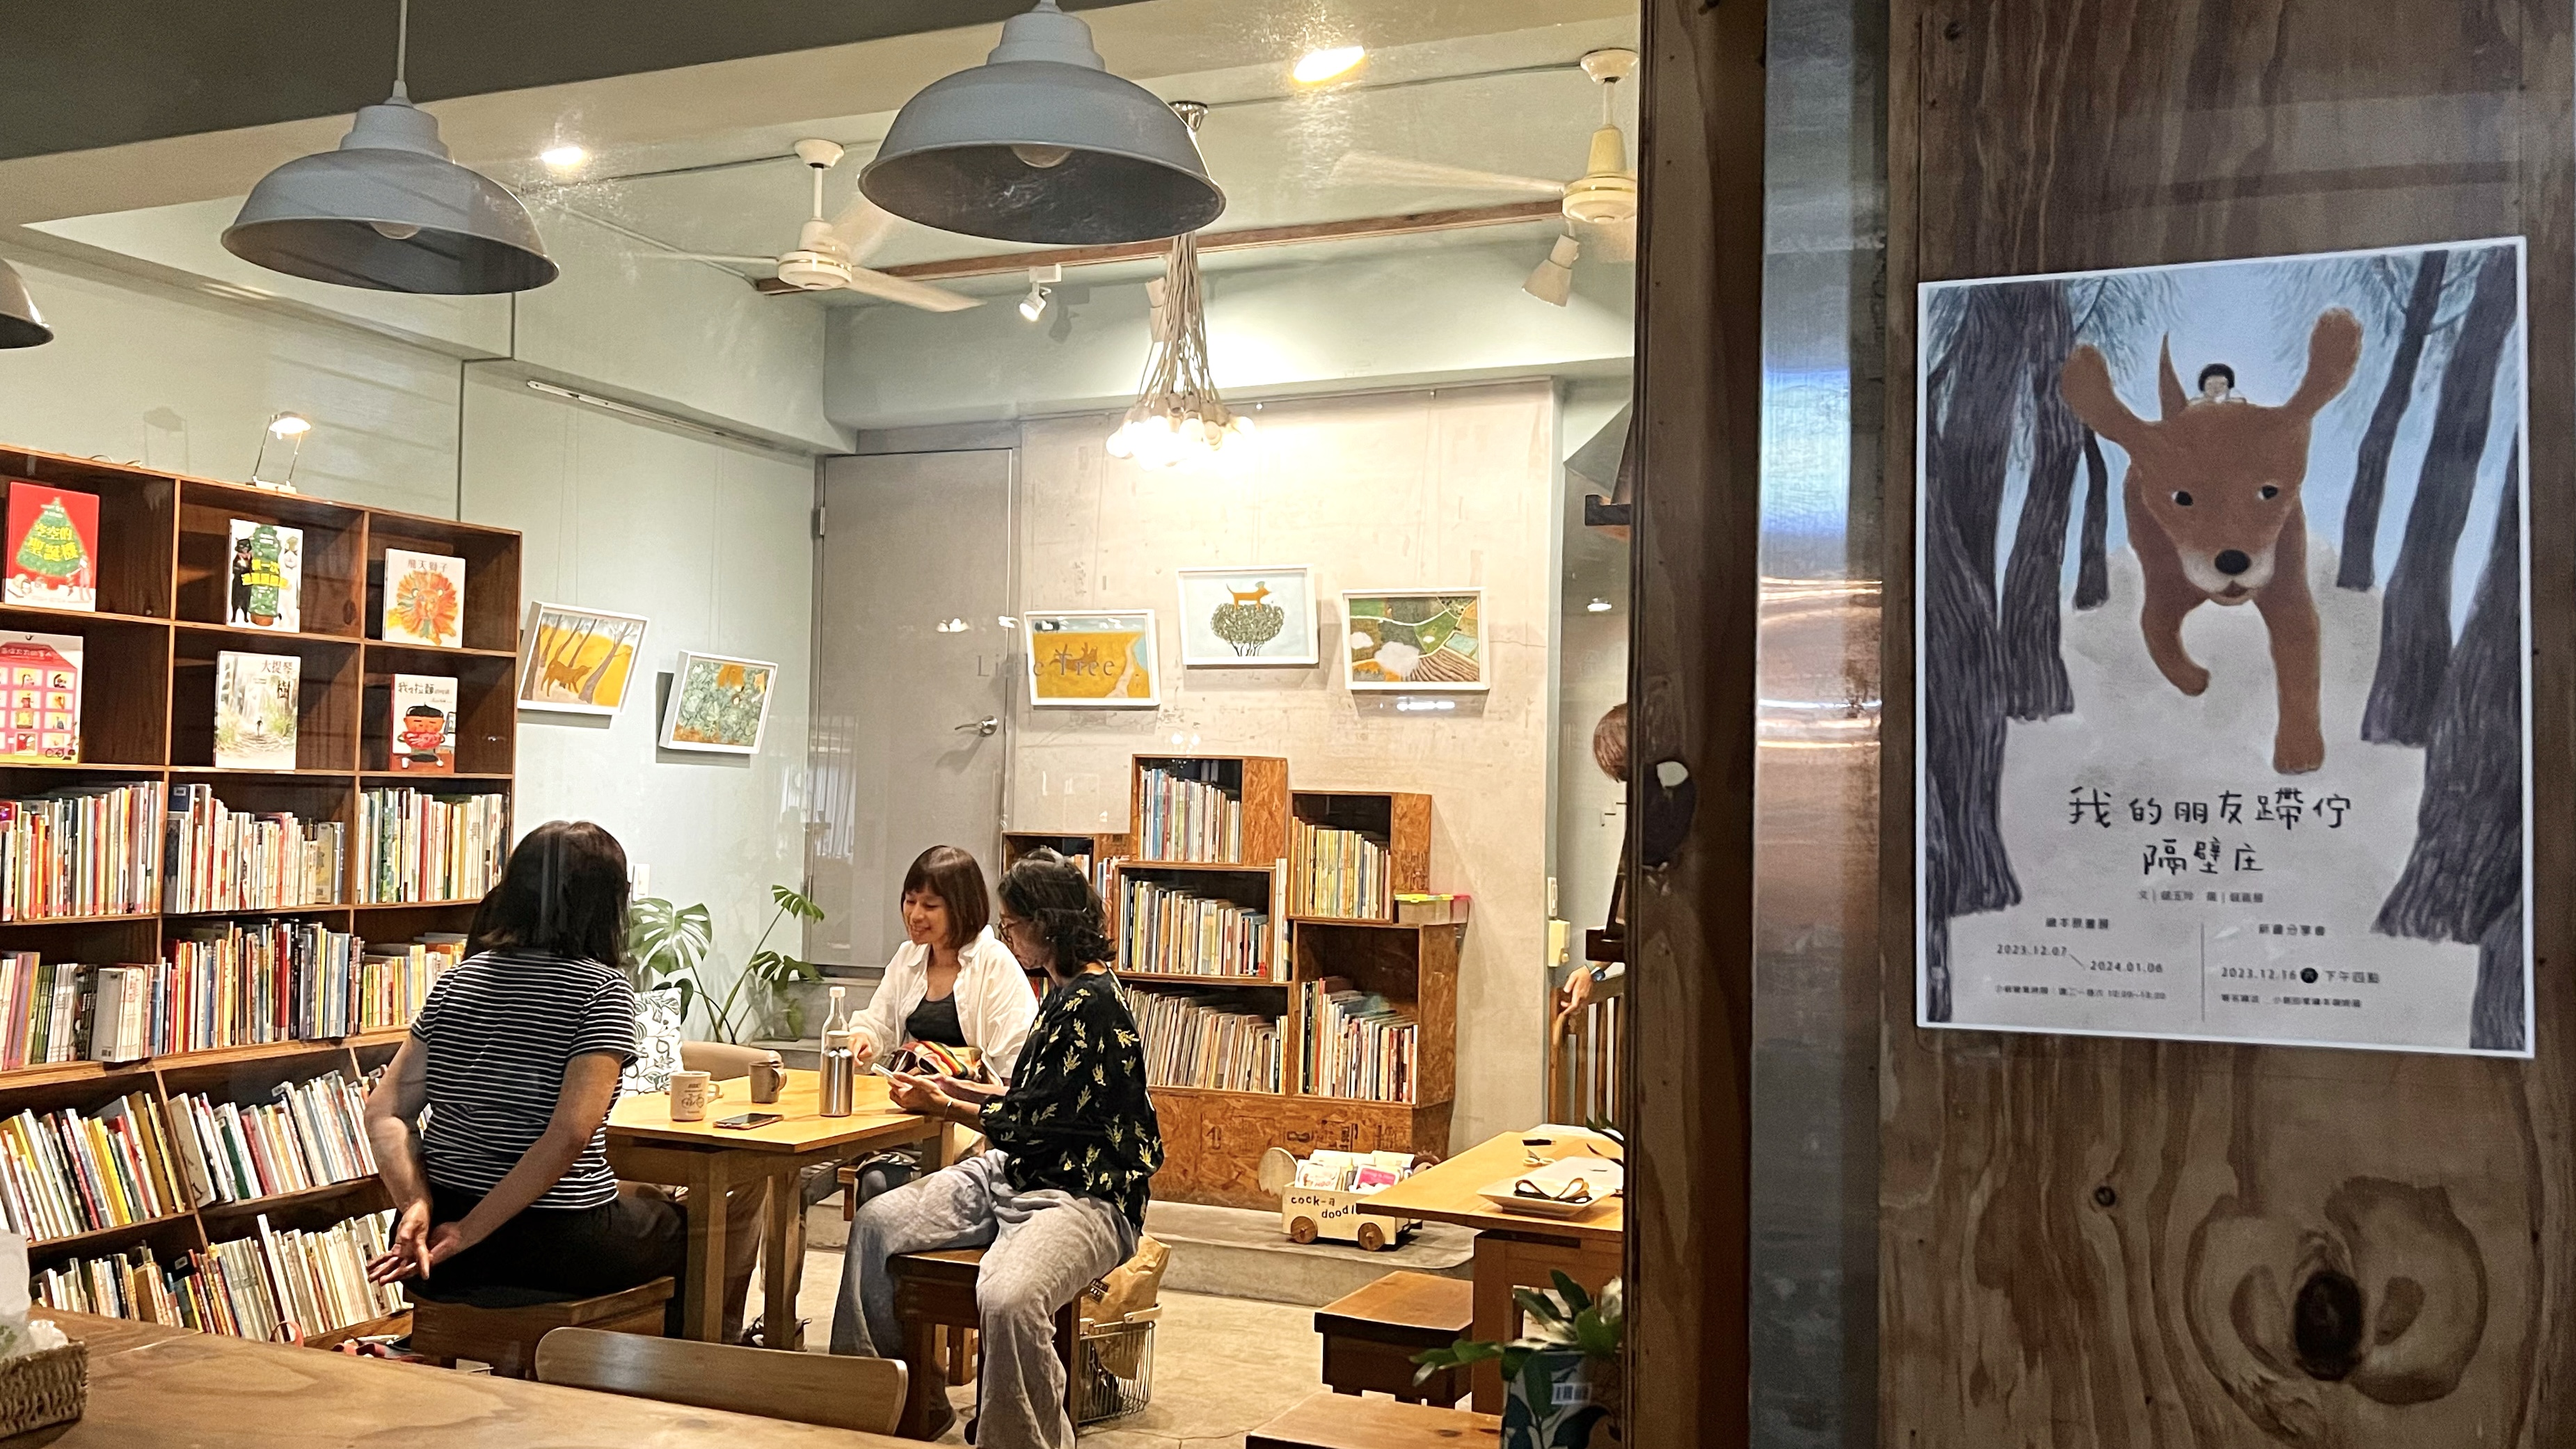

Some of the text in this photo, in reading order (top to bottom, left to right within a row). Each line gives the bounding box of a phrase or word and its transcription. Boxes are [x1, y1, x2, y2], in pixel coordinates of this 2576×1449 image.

[977, 653, 1044, 676] Lile
[2069, 786, 2351, 831] 我的朋友蹛佇
[2142, 837, 2264, 876] 隔壁庄
[1321, 1205, 1358, 1219] doodl
